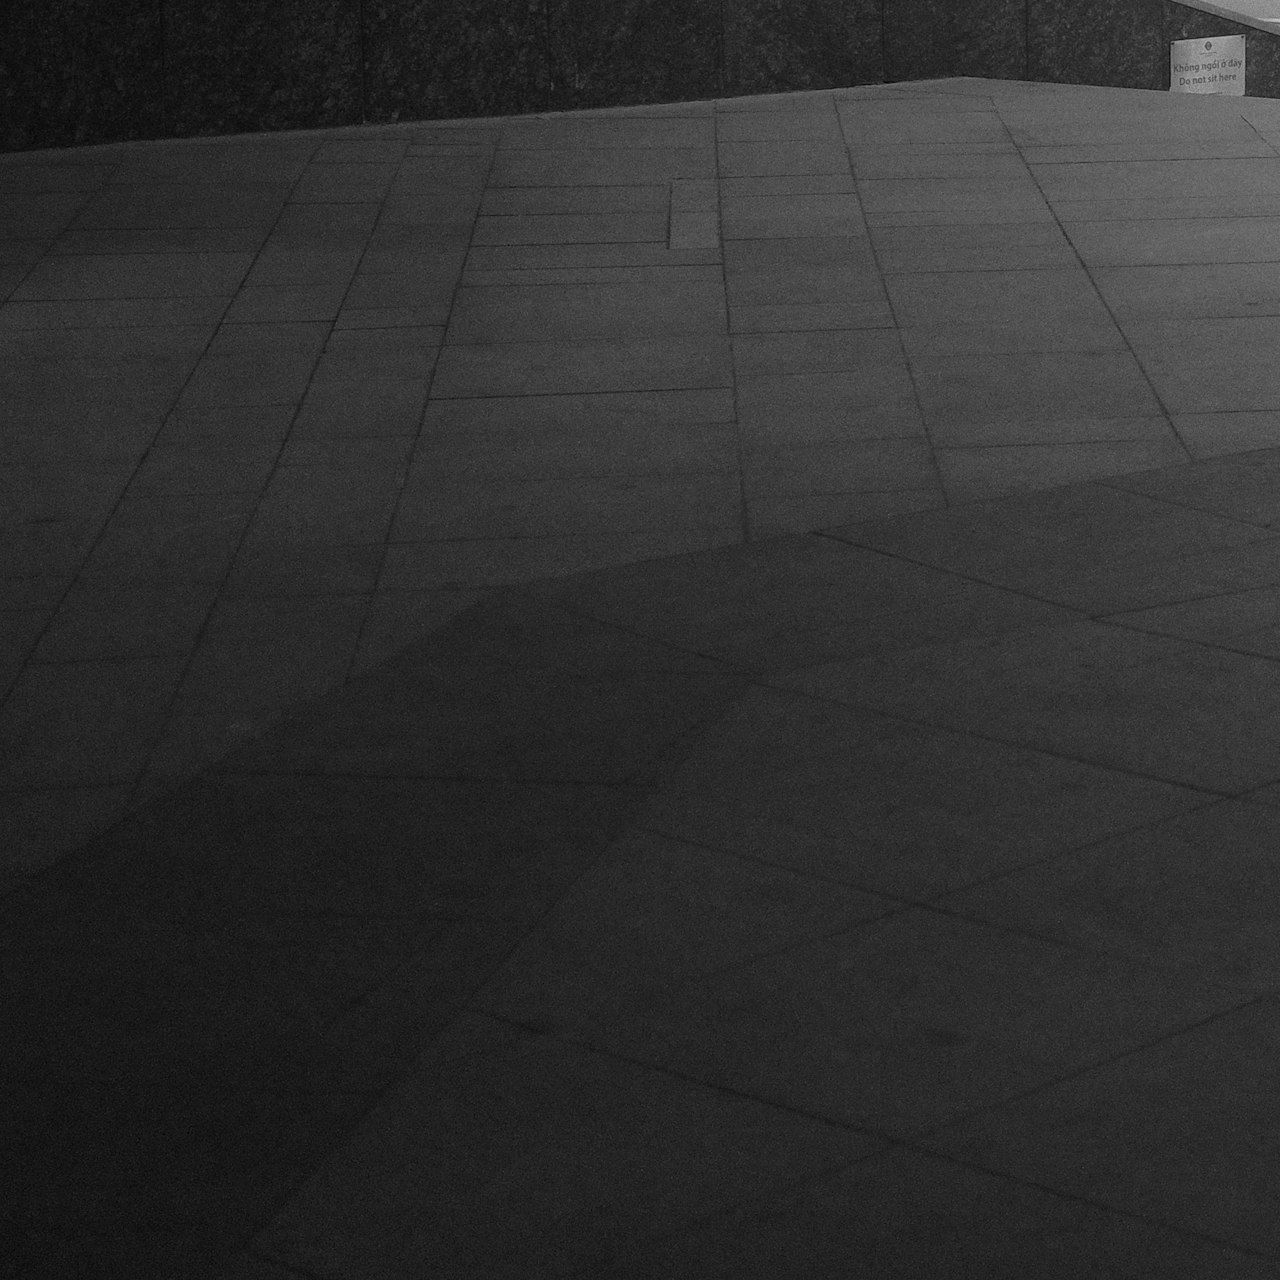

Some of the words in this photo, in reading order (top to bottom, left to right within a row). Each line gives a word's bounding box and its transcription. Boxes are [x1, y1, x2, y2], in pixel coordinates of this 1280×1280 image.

[1173, 63, 1200, 73] Không
[1179, 77, 1191, 86] Do
[1192, 76, 1206, 84] not
[1207, 74, 1218, 83] sit
[1219, 73, 1237, 82] here
